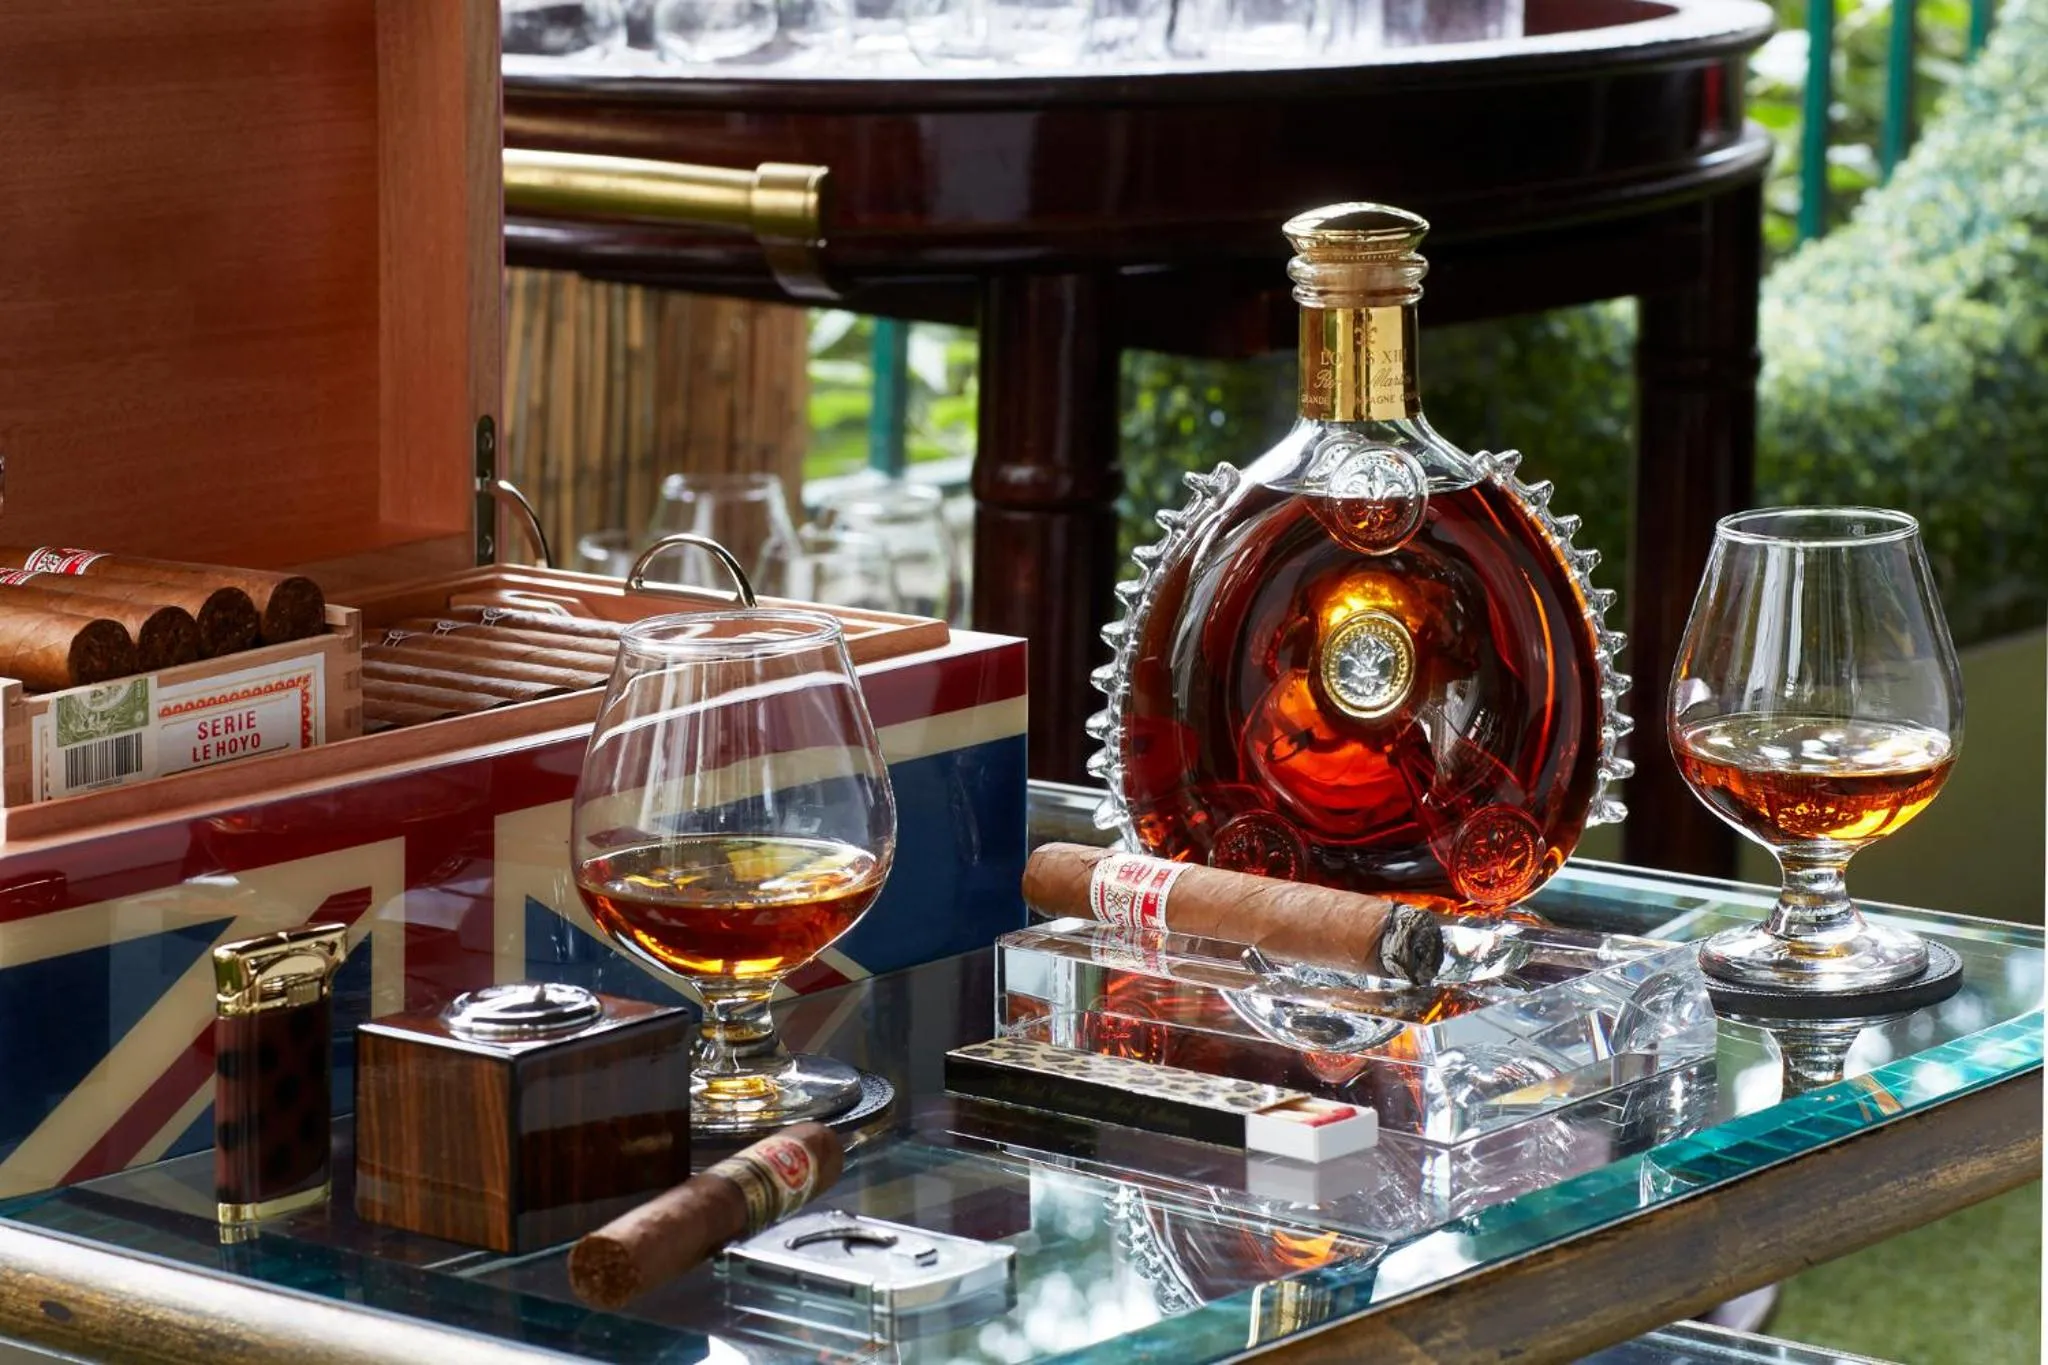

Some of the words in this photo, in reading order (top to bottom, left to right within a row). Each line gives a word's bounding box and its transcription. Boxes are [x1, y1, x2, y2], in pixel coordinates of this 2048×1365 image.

[197, 710, 257, 741] SERIE
[191, 743, 211, 763] LE
[215, 732, 262, 758] HOYO
